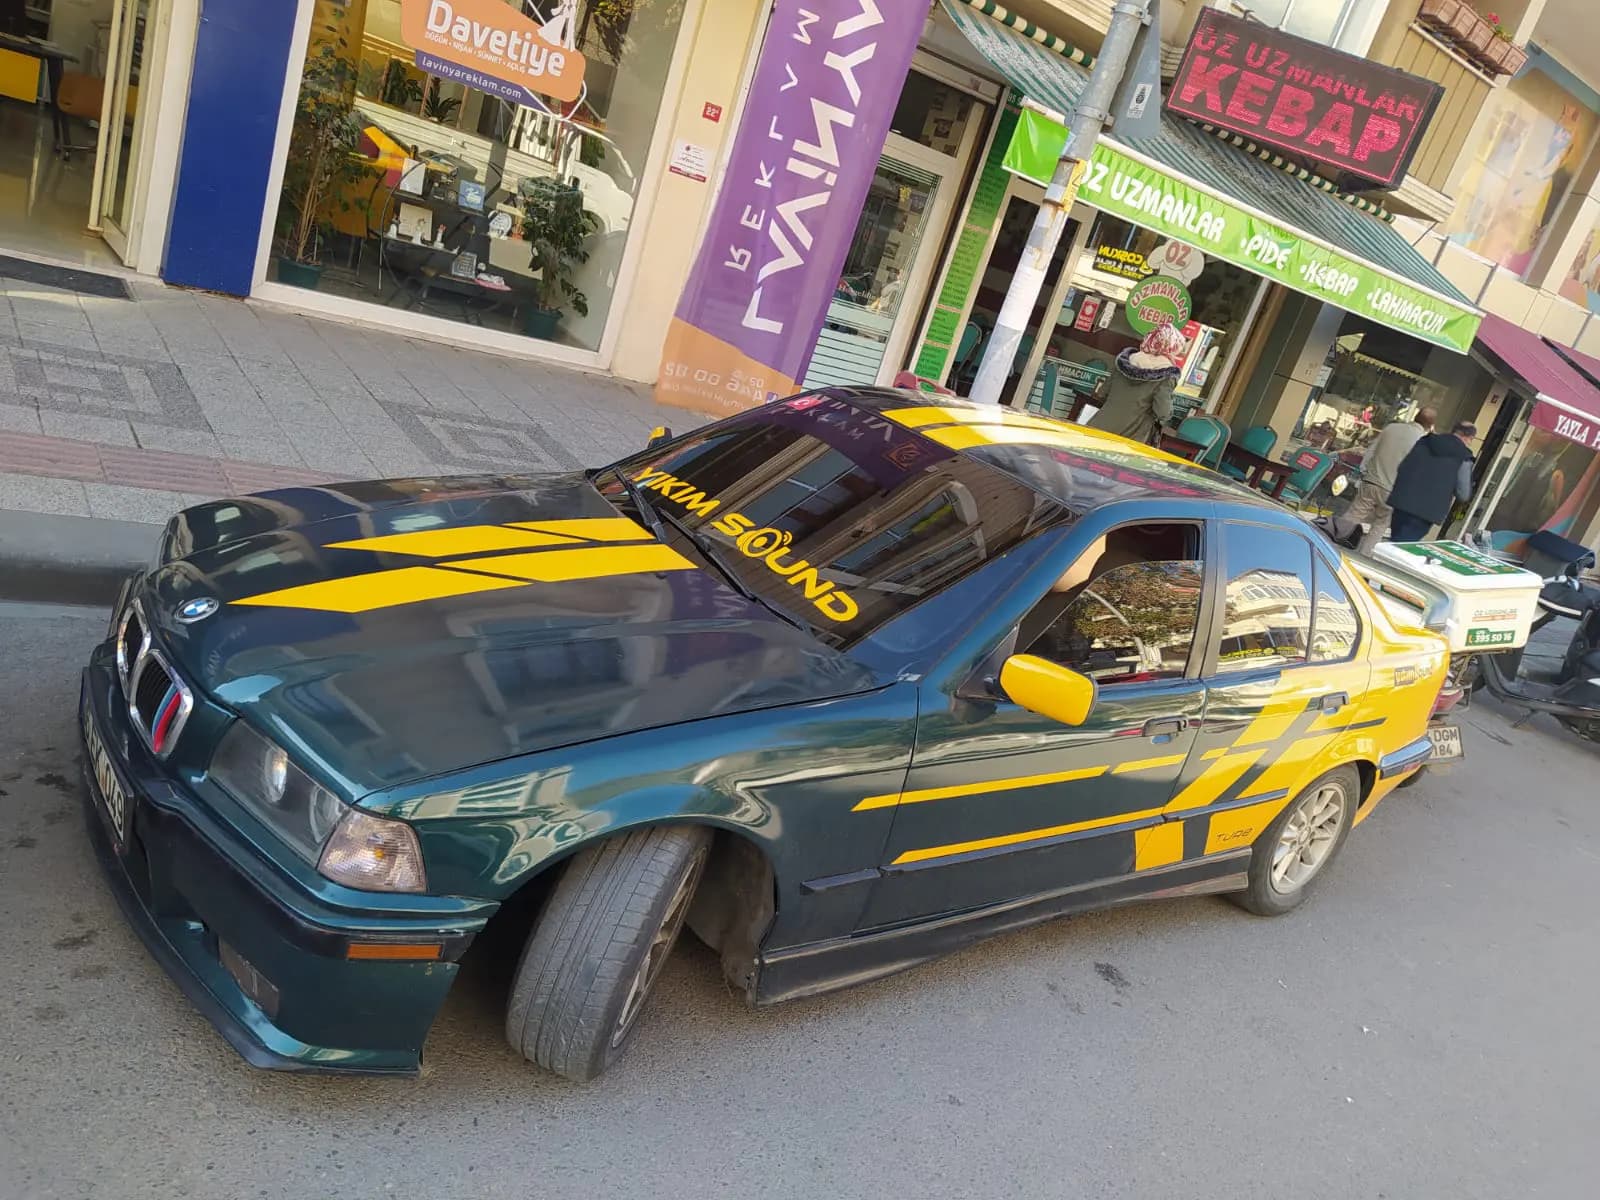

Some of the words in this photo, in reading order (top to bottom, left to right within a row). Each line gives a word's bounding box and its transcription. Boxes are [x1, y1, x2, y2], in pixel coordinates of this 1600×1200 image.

[427, 0, 565, 77] Davetiye
[423, 56, 522, 99] lavinyareklam.com
[1180, 55, 1401, 162] KEBAP
[1244, 42, 1418, 121] UZMANLAR
[1110, 171, 1226, 242] UZMANLAR
[1303, 259, 1359, 297] KEBAP
[1371, 287, 1448, 335] LAHMACUN
[1131, 282, 1188, 322] UZMANLAR
[1554, 414, 1590, 443] YAYLA
[632, 466, 721, 518] YIKIM
[711, 513, 859, 622] SOUND
[1433, 729, 1458, 742] DGM
